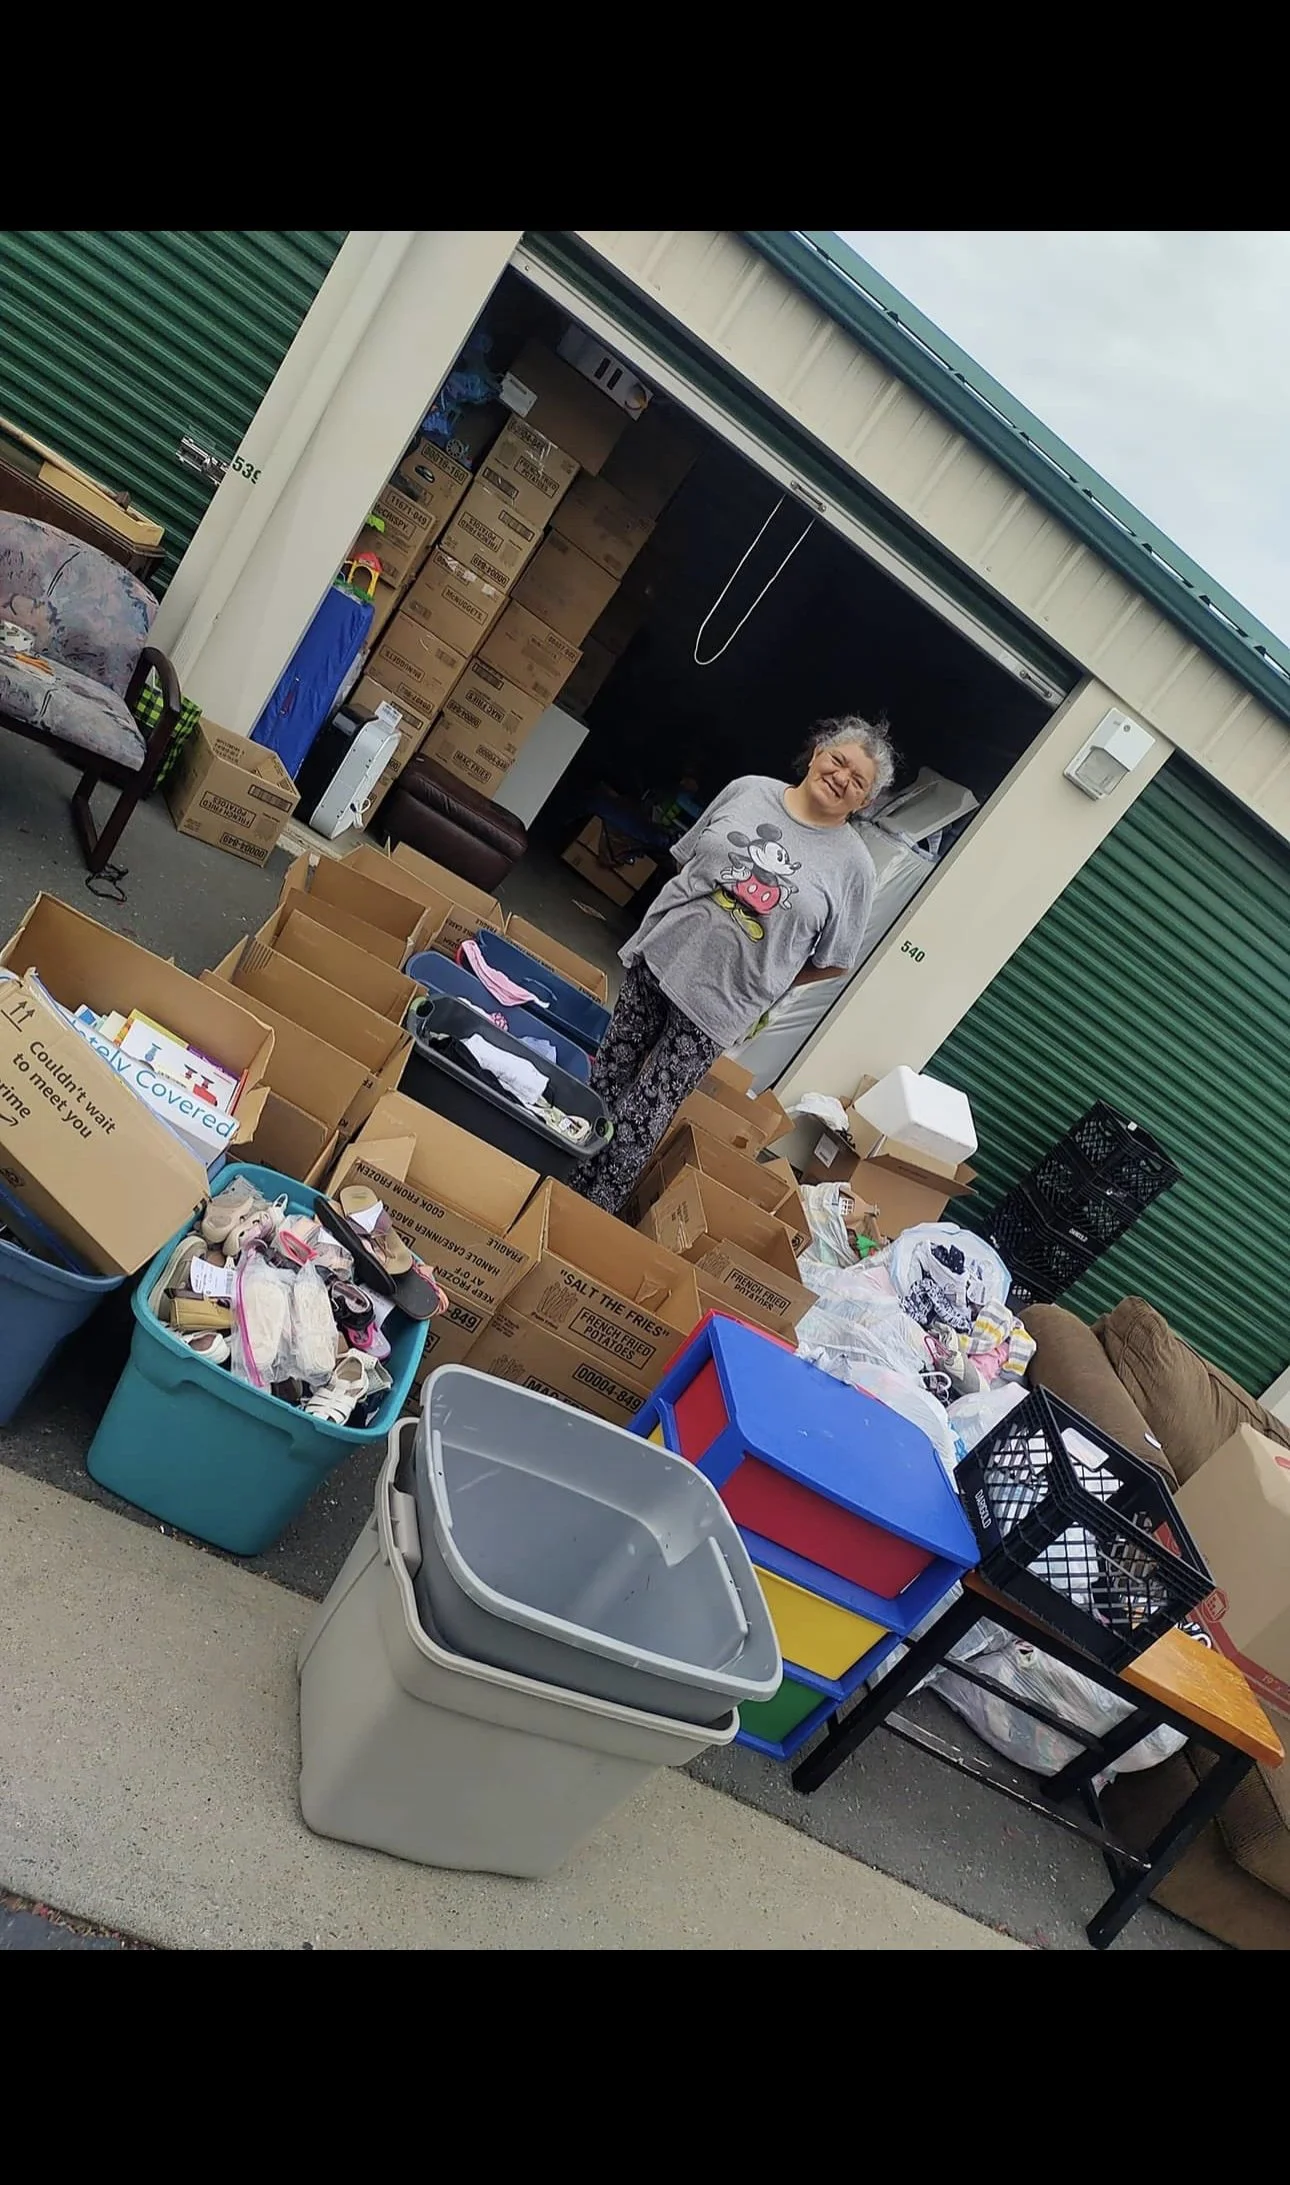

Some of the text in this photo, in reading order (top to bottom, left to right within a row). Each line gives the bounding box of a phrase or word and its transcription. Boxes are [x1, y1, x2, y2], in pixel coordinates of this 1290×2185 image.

[900, 940, 926, 962] 540
[0, 1080, 31, 1118] rime
[12, 1053, 92, 1139] to meet you
[30, 1041, 116, 1135] Couldn't wait
[136, 1070, 235, 1138] Covered
[356, 1162, 446, 1220] COOK FROM FROZEN
[390, 1206, 414, 1228] BAGS
[414, 1222, 466, 1256] CASE/INNER
[486, 1237, 525, 1264] FRAGILE
[465, 1250, 501, 1277] HANDLE
[470, 1274, 485, 1287] AT
[433, 1265, 495, 1304] KEEP FROZEN
[560, 1269, 670, 1338] "SALT THE FRIES"
[730, 1271, 788, 1309] FRENCH FRIED
[734, 1284, 774, 1311] POTATOES
[580, 1312, 622, 1342] FRENCH
[622, 1334, 652, 1358] FRIED
[584, 1326, 636, 1360] POTATOES
[576, 1367, 642, 1410] 00004-849
[974, 1488, 992, 1529] DARIGOLD
